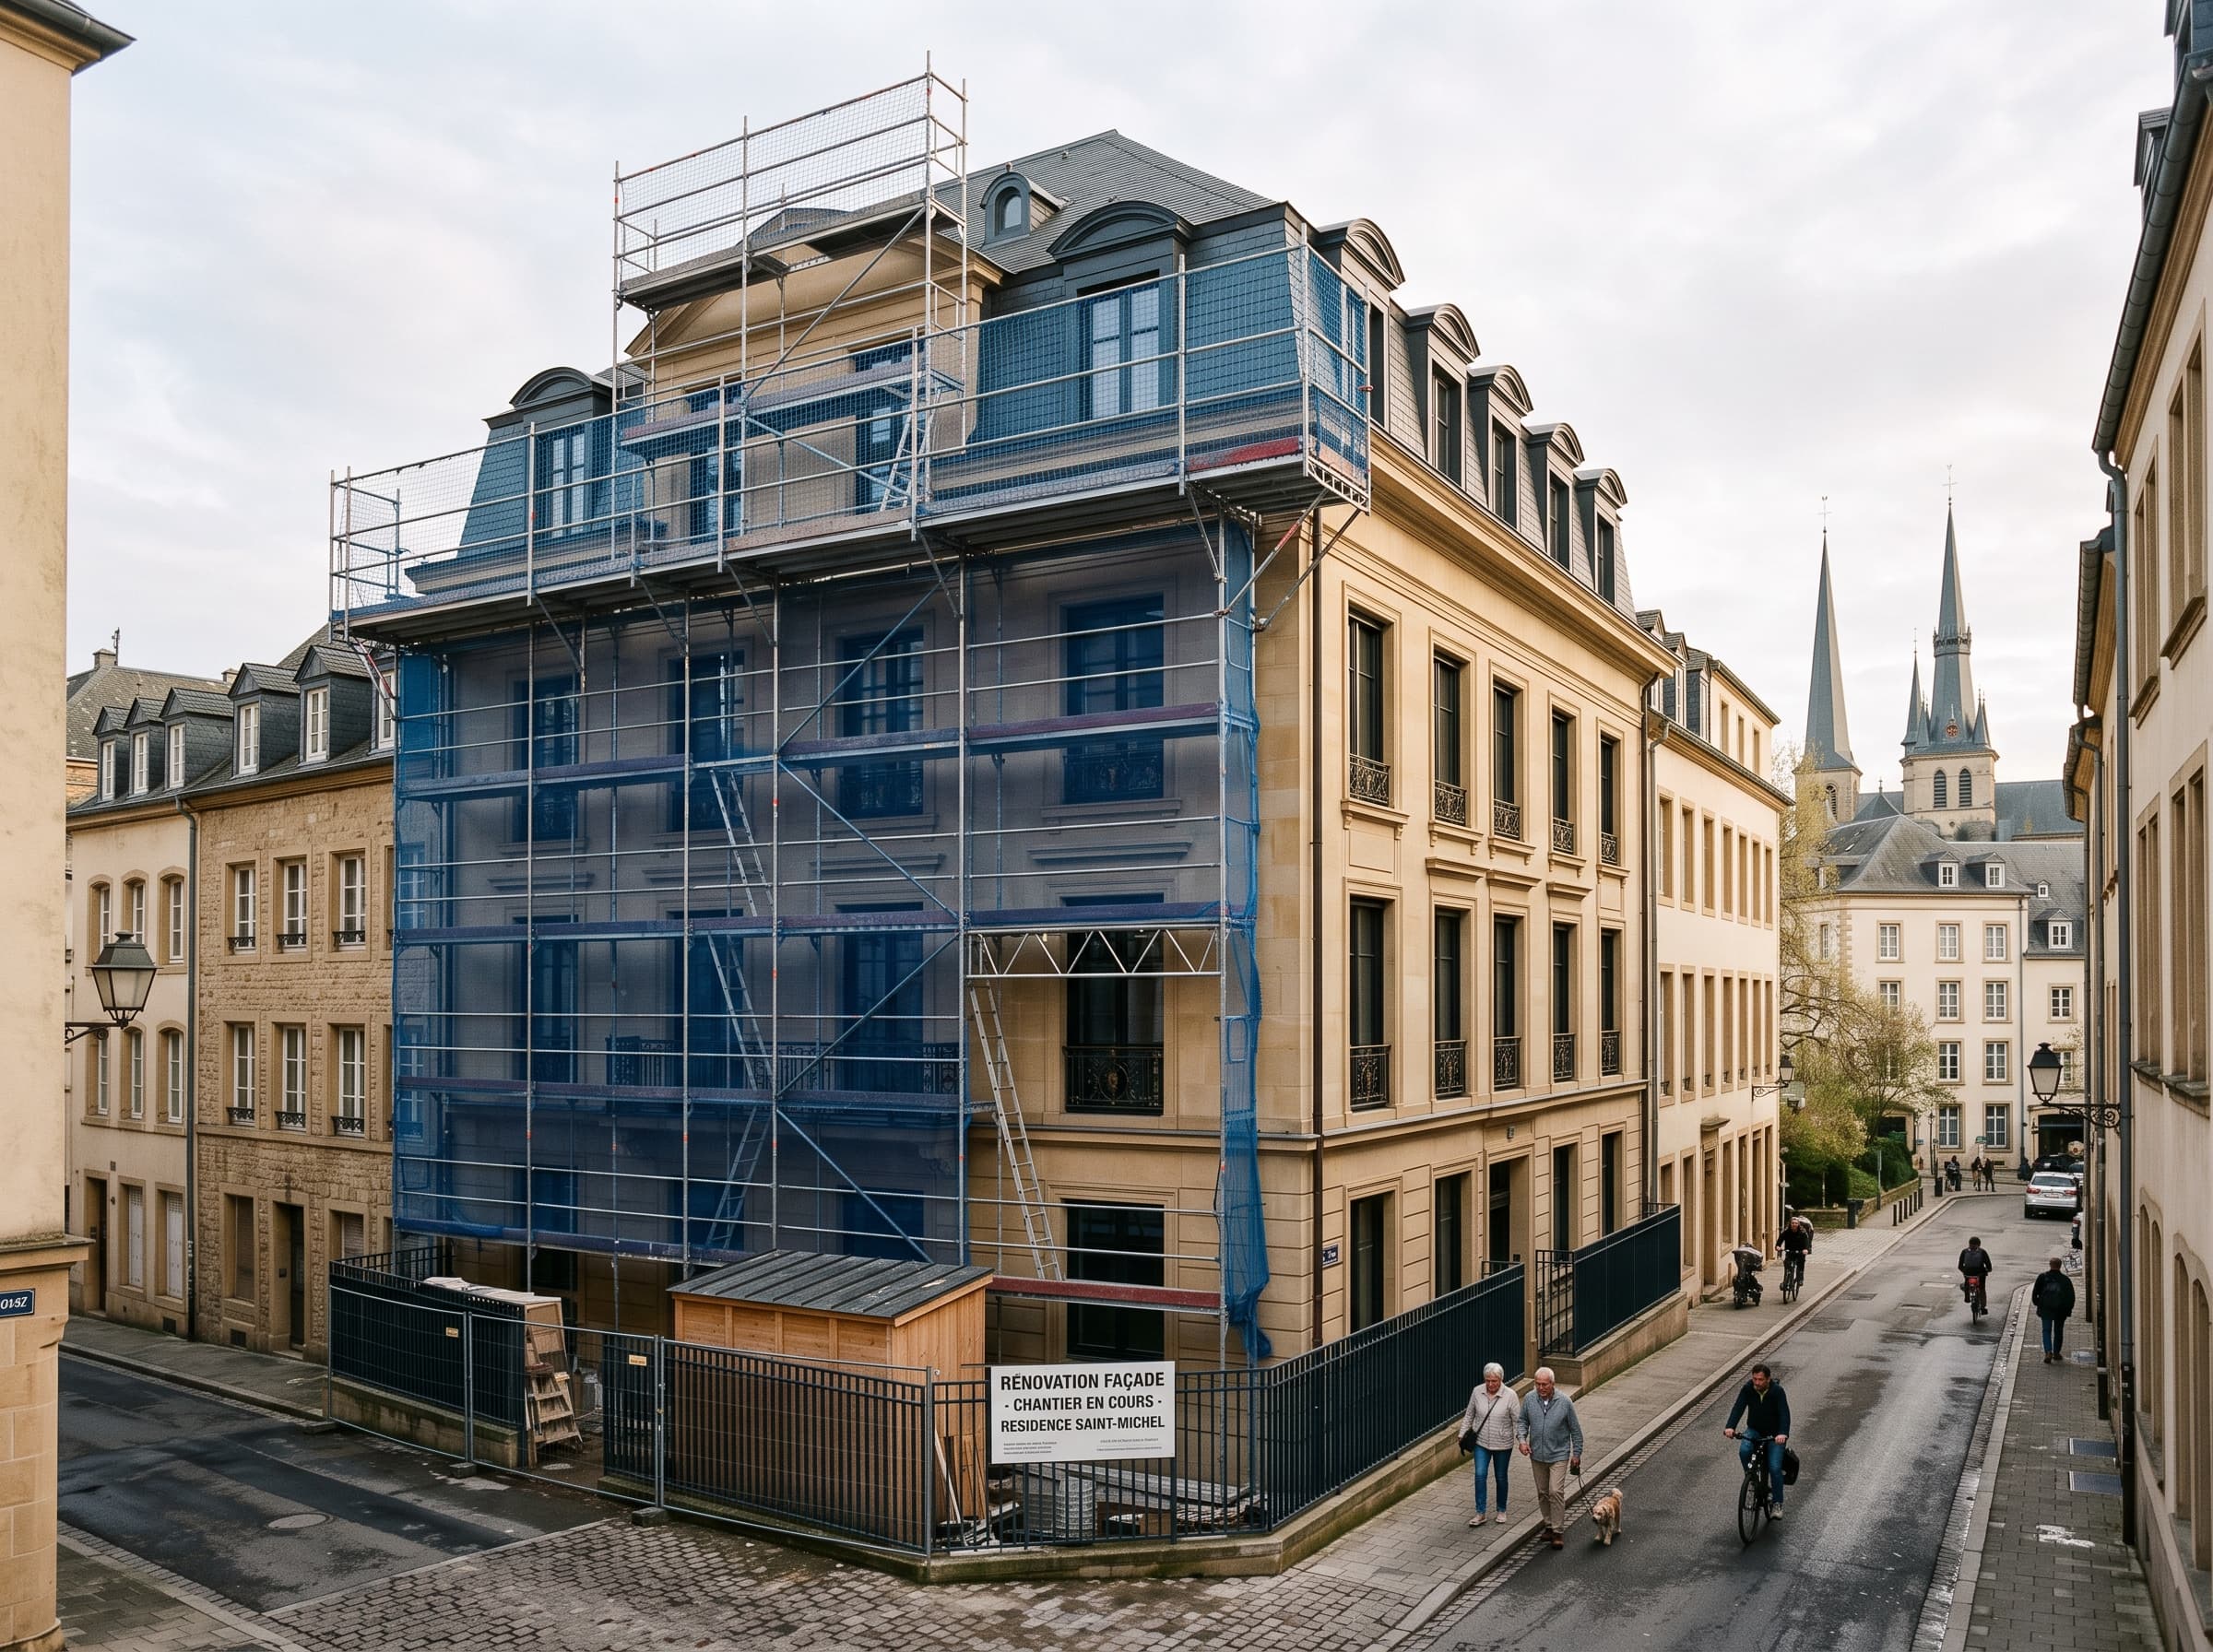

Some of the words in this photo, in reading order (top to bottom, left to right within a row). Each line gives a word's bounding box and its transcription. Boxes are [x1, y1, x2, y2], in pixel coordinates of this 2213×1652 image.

[1104, 1371, 1166, 1391] FAÇADE
[1013, 1397, 1083, 1412] CHANTIER
[1086, 1396, 1105, 1410] EN
[1108, 1394, 1154, 1410] COURS
[1000, 1418, 1072, 1433] RESIDENCE
[1075, 1415, 1166, 1431] SAINT-MICHEL
